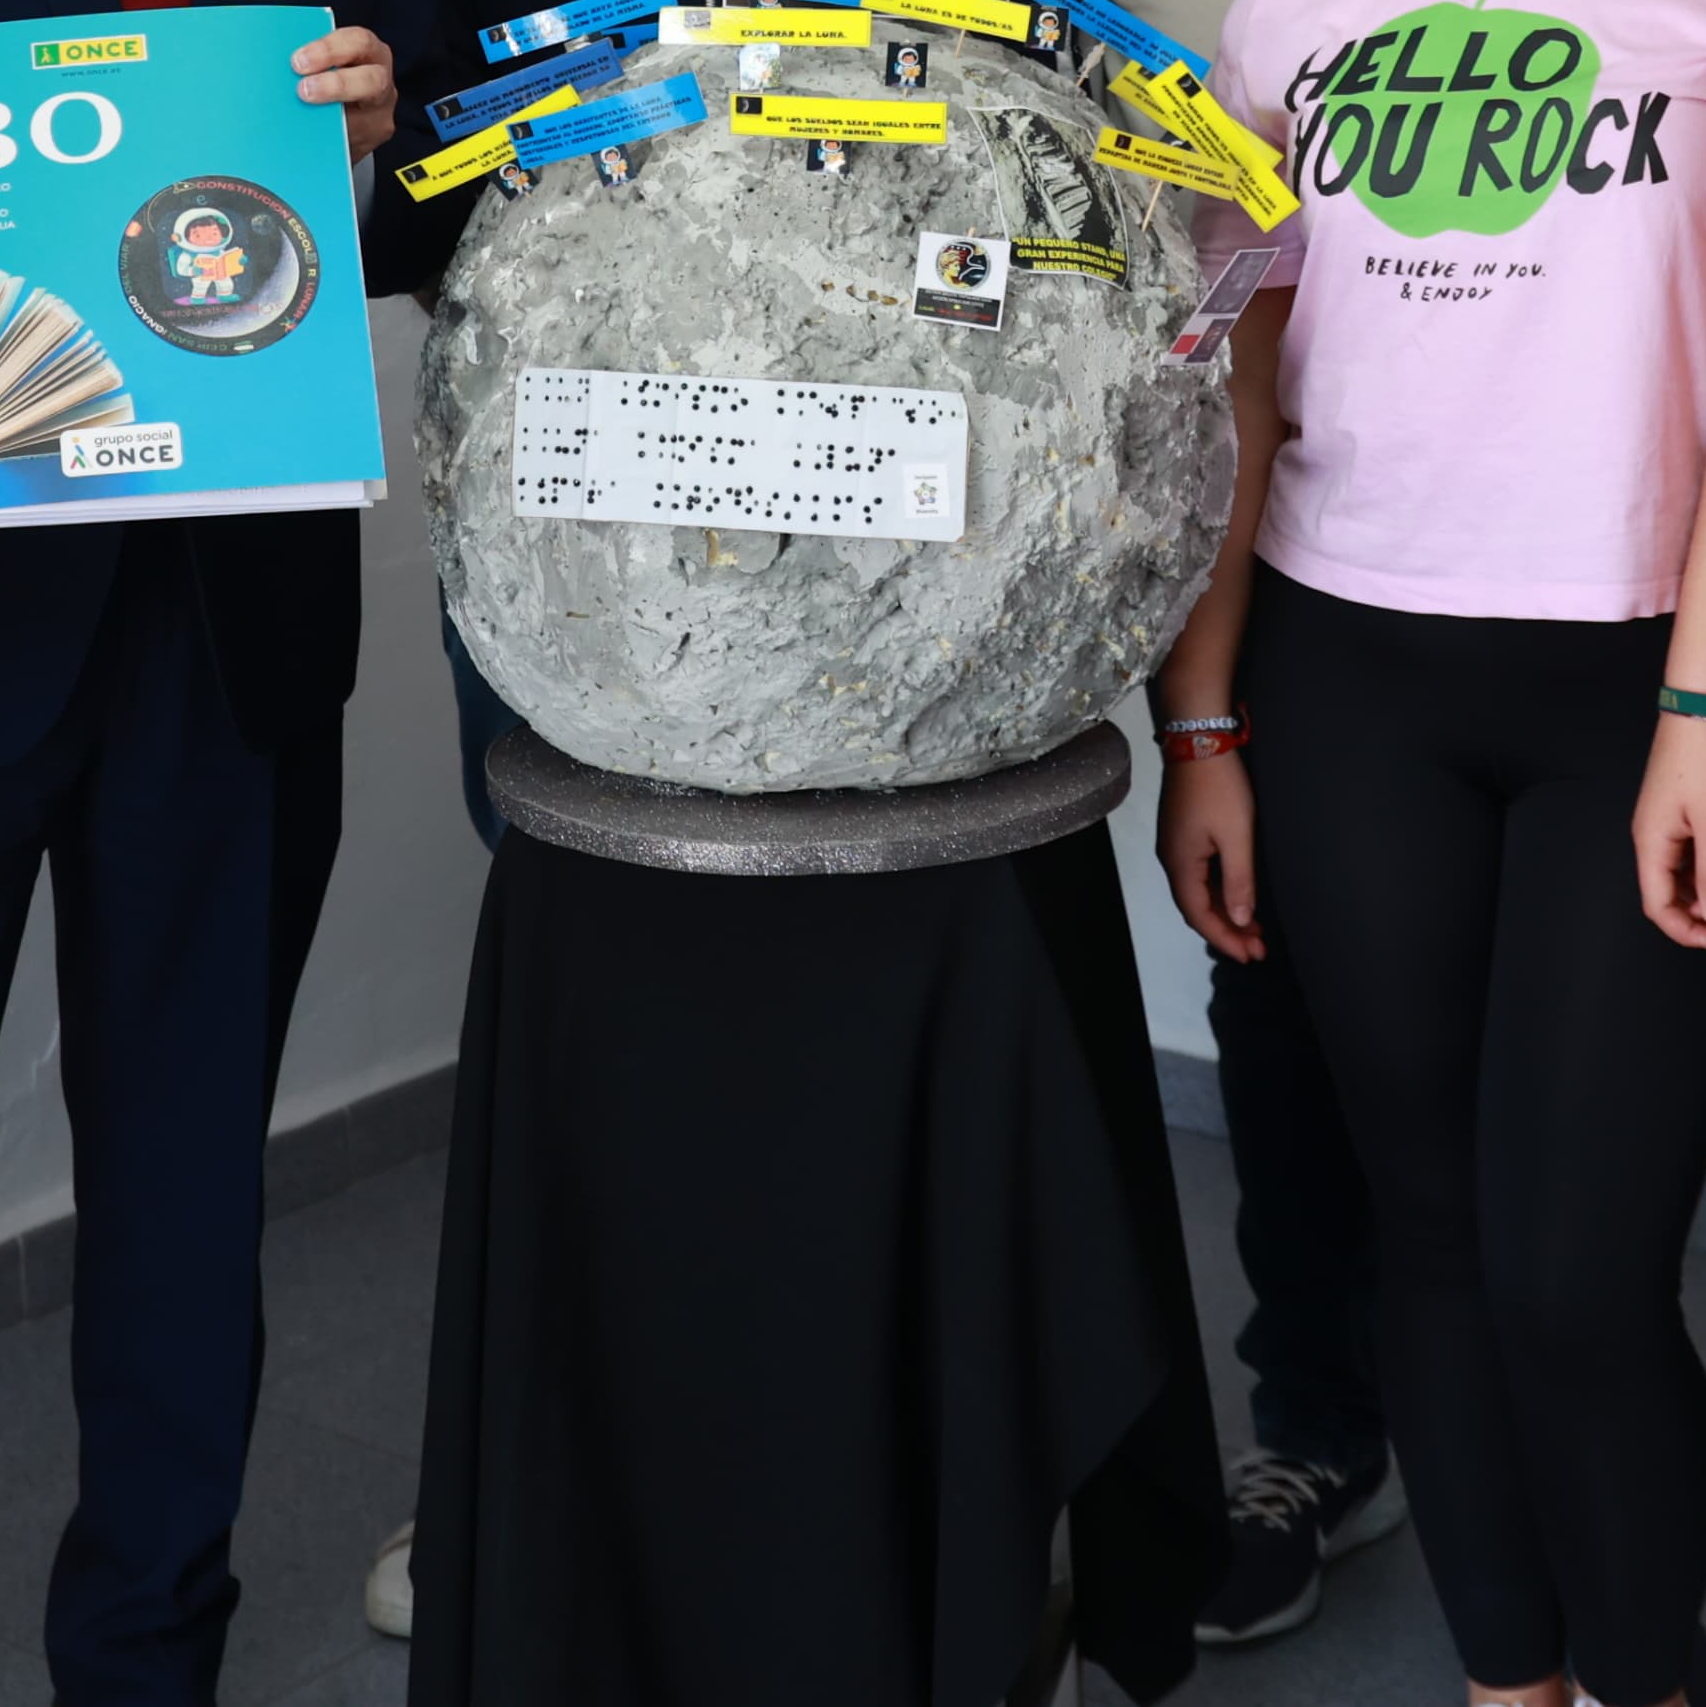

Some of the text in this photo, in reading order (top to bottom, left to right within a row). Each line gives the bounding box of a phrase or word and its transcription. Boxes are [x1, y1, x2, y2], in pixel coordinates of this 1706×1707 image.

[914, 4, 938, 14] LUNA
[941, 10, 953, 18] ES
[741, 29, 847, 39] EXPLORAR LA LUNA.
[66, 40, 138, 60] ONCE
[1284, 25, 1583, 113] HELLO
[789, 126, 830, 134] MUJERES
[805, 117, 843, 126] SUELDOS
[846, 119, 869, 127] SEAN
[872, 121, 910, 129] IGUALES
[913, 122, 941, 130] ENTRE
[1293, 101, 1443, 200] YOU
[1458, 91, 1672, 197] ROCK
[1017, 249, 1046, 258] GRAN
[1047, 250, 1105, 267] EXPERIENCIA
[1033, 261, 1080, 271] NUESTRO
[1365, 256, 1458, 279] BELIEVE
[1473, 262, 1497, 276] IN
[1400, 282, 1493, 301] & ENJOY
[128, 295, 167, 335] IGNACIO
[94, 430, 173, 447] grupo social
[96, 445, 174, 466] ONCE
